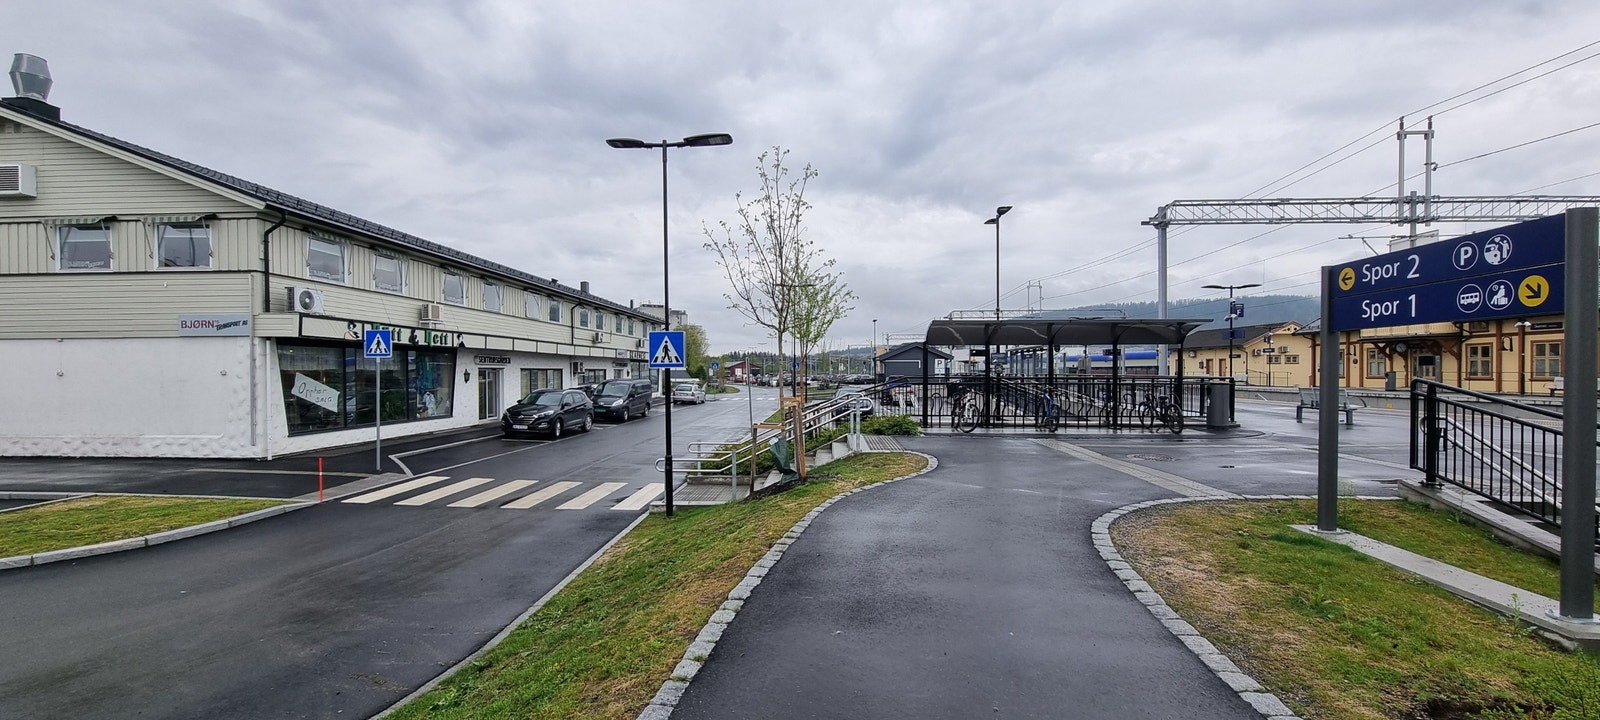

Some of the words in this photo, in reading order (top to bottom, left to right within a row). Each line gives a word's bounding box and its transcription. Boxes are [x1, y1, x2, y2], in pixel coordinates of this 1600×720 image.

[1460, 246, 1473, 266] P
[1362, 262, 1400, 285] Spor
[1407, 254, 1420, 279] 2
[1361, 299, 1400, 322] Spor
[1408, 294, 1416, 318] 1
[937, 359, 943, 368] P
